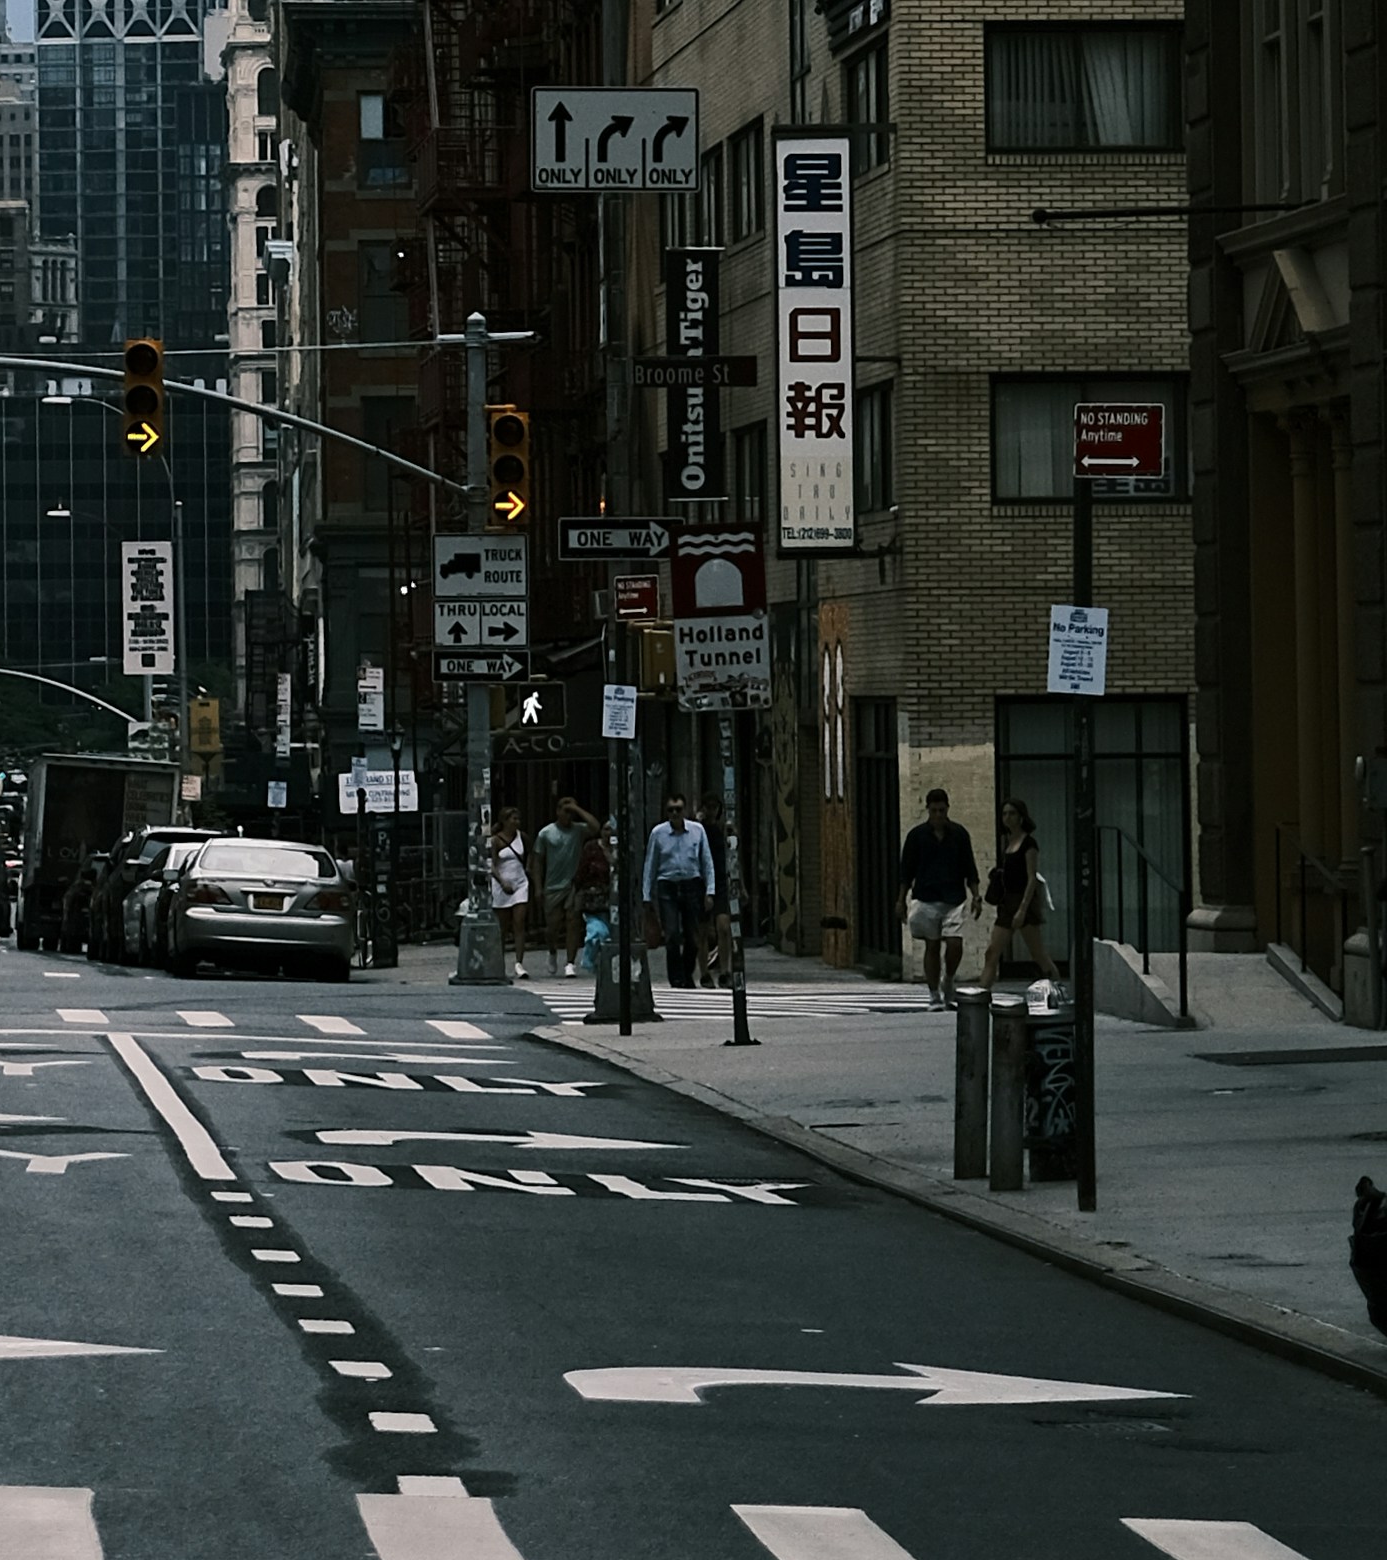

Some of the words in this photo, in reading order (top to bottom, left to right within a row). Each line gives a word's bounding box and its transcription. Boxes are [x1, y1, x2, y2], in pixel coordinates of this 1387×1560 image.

[538, 168, 582, 184] ONLY
[594, 168, 637, 184] ONLY
[649, 168, 693, 184] ONLY
[679, 258, 709, 345] Tiger
[784, 153, 845, 439] 星島日報
[634, 364, 705, 384] Broome
[712, 363, 730, 384] St
[1080, 412, 1095, 425] NO
[1097, 412, 1148, 425] STANDING
[1080, 428, 1123, 444] Anytime
[790, 462, 842, 478] SING
[783, 506, 851, 521] DAILY
[577, 531, 613, 547] ONE
[629, 531, 665, 547] WAY
[484, 549, 522, 561] TRUCK
[484, 570, 522, 582] ROUTE
[438, 604, 477, 616] THRU
[482, 604, 524, 616] LOCAL
[679, 624, 764, 644] Holland
[1053, 623, 1066, 632] No
[1069, 623, 1104, 637] Parking
[685, 648, 761, 668] Tunnel
[447, 660, 474, 672] ONE
[486, 660, 515, 673] WAY
[191, 1066, 607, 1096] ONLY
[269, 1160, 815, 1205] ONLY
